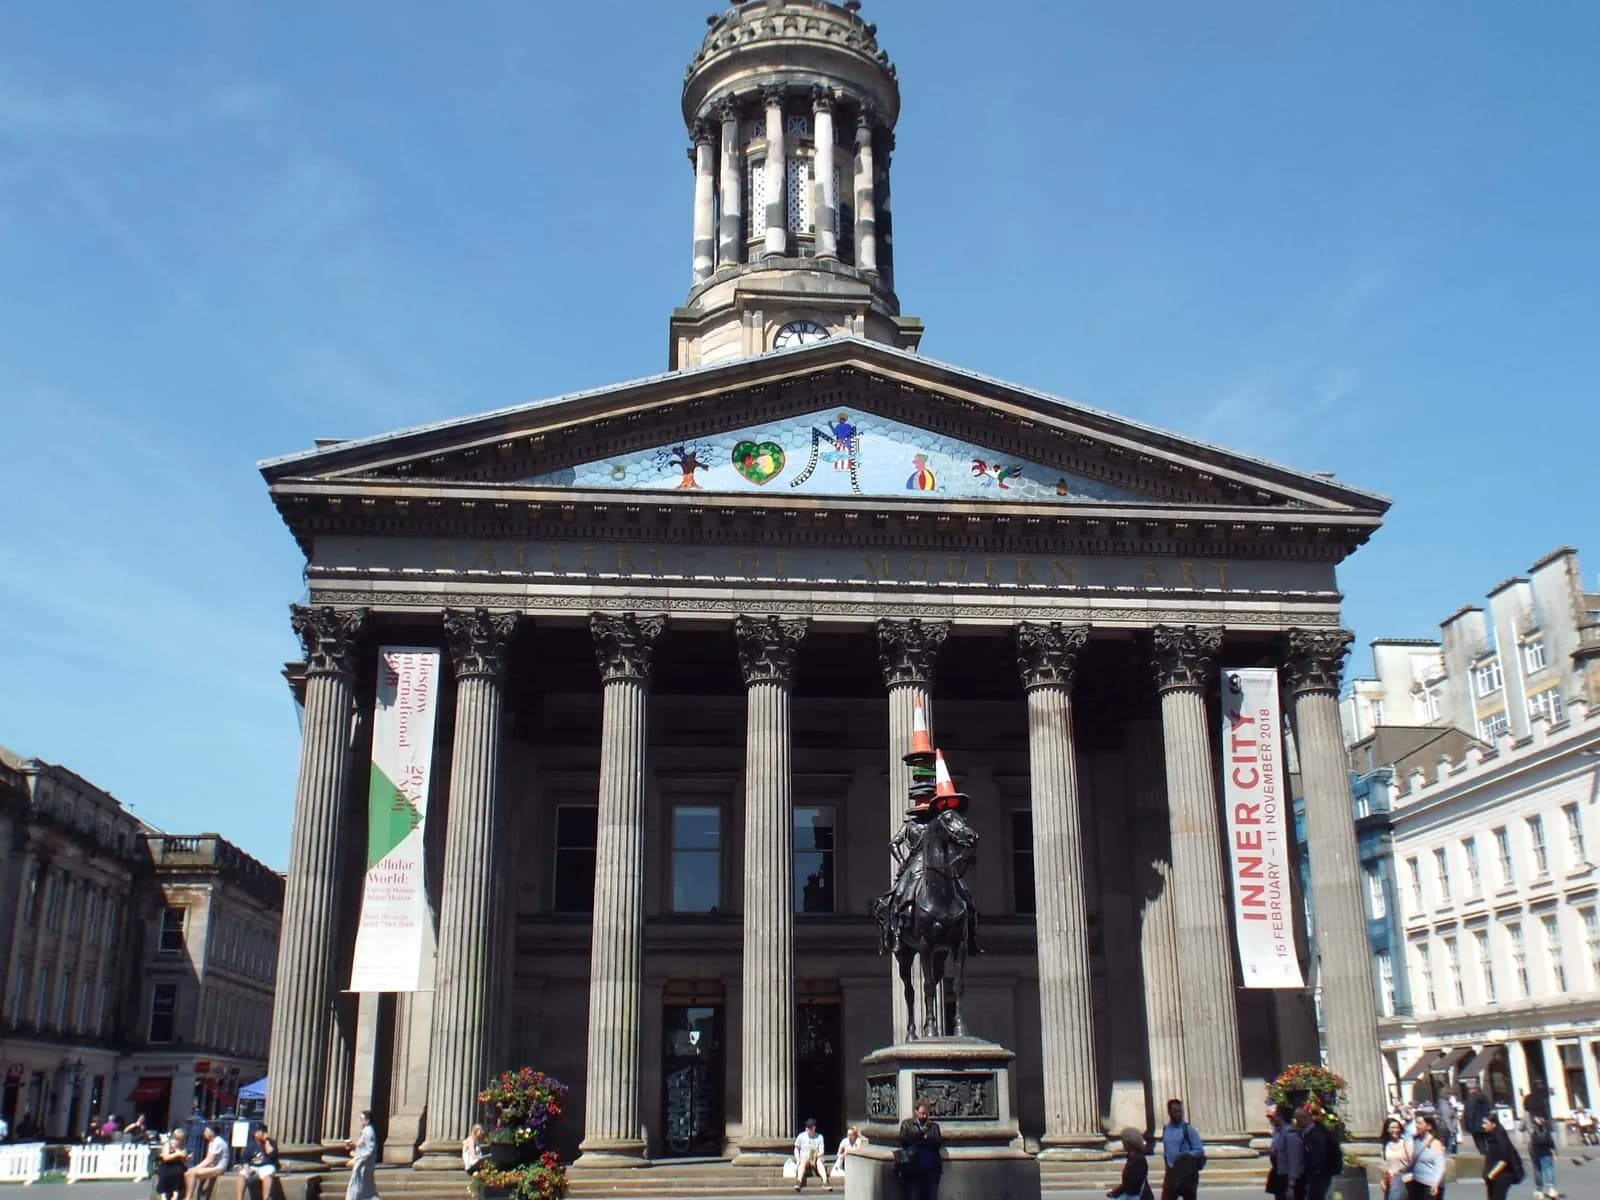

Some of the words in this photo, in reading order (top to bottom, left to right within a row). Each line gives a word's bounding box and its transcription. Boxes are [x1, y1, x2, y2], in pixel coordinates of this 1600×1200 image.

[434, 544, 664, 571] GALLERY
[736, 550, 793, 576] OF
[860, 553, 1078, 583] MODERN
[1142, 560, 1231, 589] ART
[385, 650, 400, 686] 2018
[413, 651, 433, 714] Glasgow
[399, 651, 416, 748] International
[1259, 708, 1271, 739] 2018
[1230, 708, 1259, 790] CITY
[390, 780, 409, 811] May
[410, 765, 424, 786] 20
[1260, 743, 1277, 824] NOVEMBER
[406, 786, 422, 830] April
[1267, 830, 1278, 842] 11
[368, 872, 408, 885] World:
[1235, 803, 1268, 921] INNER
[1268, 862, 1283, 939] FEBRUARY
[1276, 944, 1287, 957] 15
